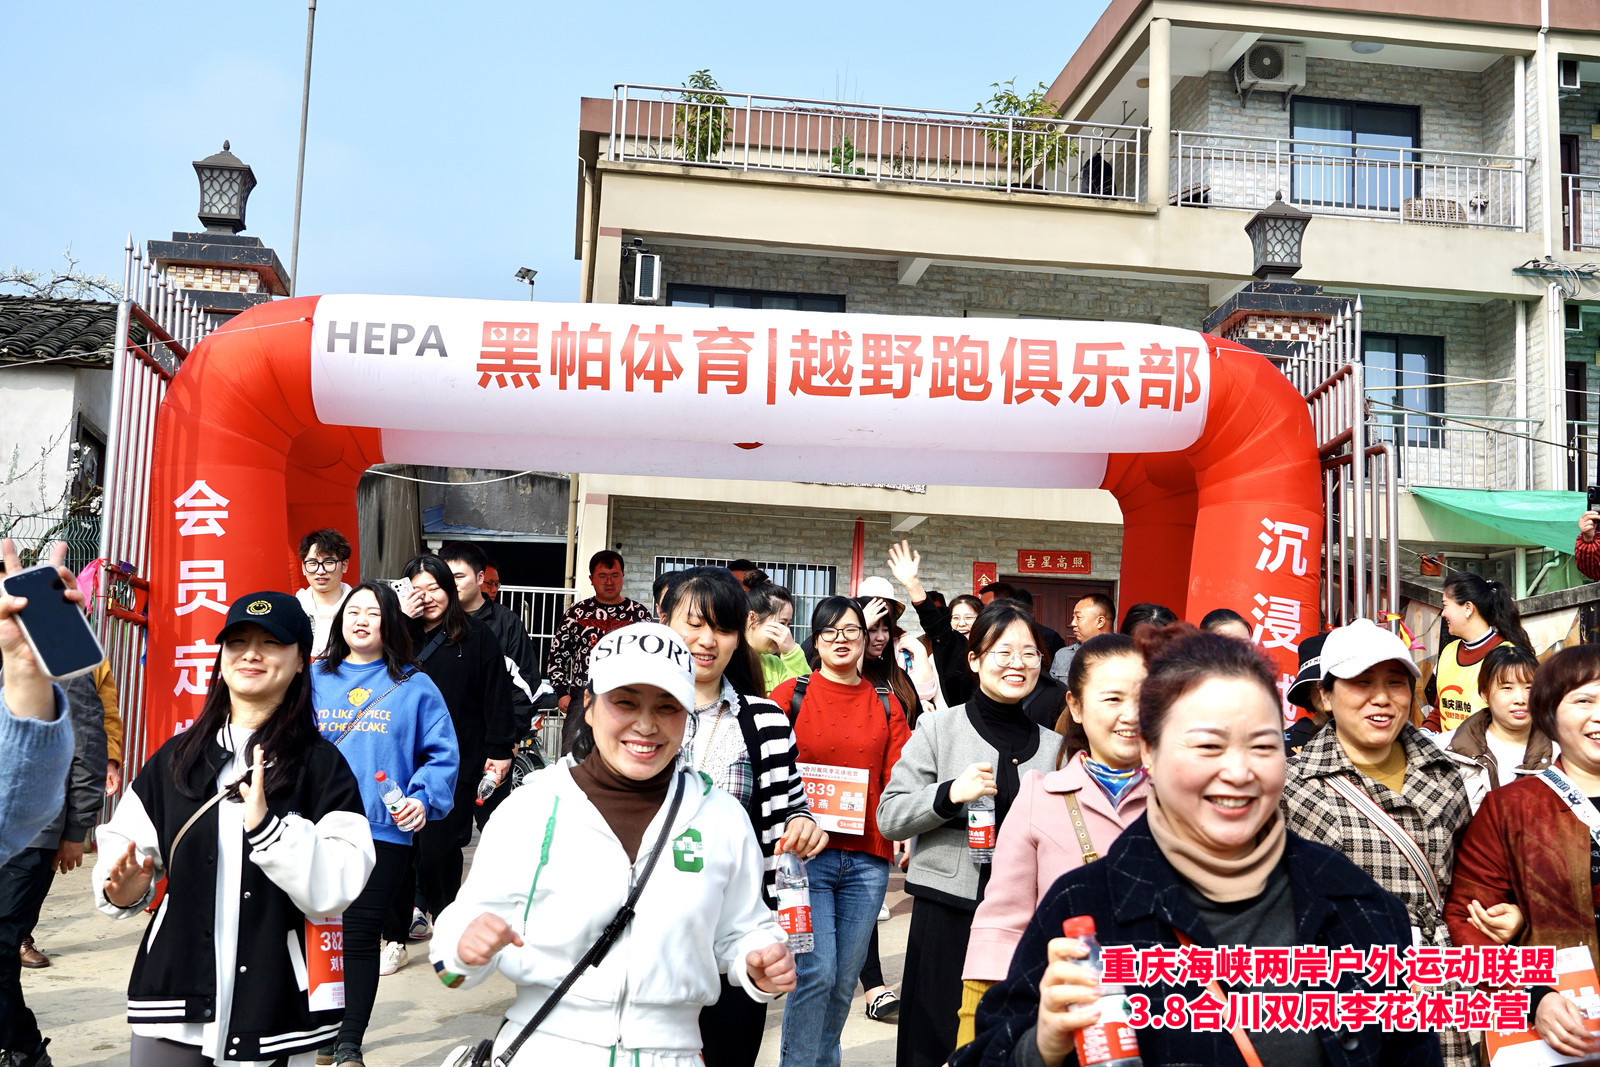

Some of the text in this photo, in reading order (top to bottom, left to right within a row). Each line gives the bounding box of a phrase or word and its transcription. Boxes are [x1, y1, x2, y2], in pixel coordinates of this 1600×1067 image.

[326, 320, 448, 357] HEPA
[476, 320, 1201, 412] 黑帕体育|越野跑俱乐部
[1025, 555, 1085, 570] 吉星高照
[595, 634, 693, 675] SPORT
[331, 708, 354, 719] LIKE
